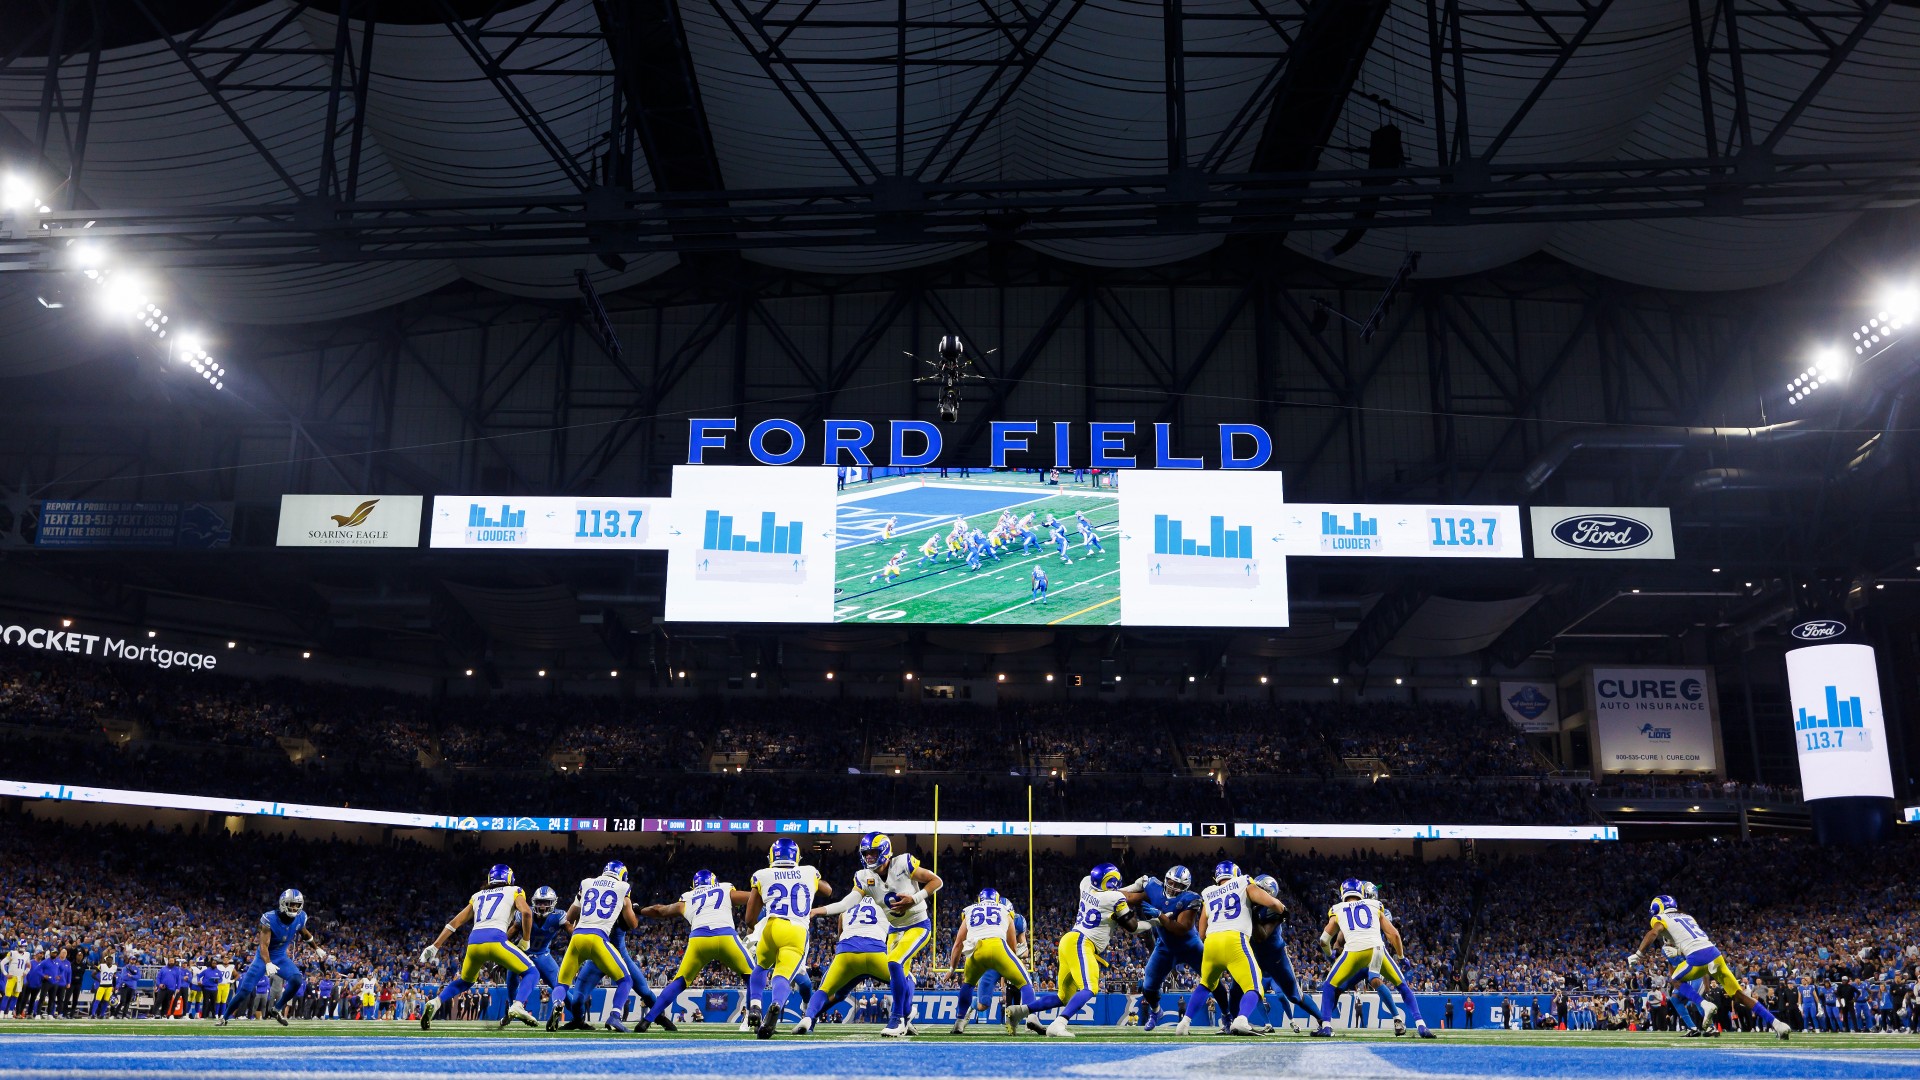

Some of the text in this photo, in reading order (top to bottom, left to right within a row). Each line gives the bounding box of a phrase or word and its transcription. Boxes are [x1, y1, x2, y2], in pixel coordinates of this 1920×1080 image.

[687, 418, 1273, 470] FORD FIELD
[45, 502, 76, 511] REPORT
[76, 502, 82, 511] A
[44, 514, 70, 525] TEXT
[575, 509, 643, 538] 113.7
[42, 526, 66, 536] WITH
[68, 527, 84, 536] THE
[85, 527, 112, 536] ISSUE
[308, 530, 389, 539] SOARING EAGLE
[477, 530, 516, 542] LOUDER
[1431, 518, 1497, 546] 113.7
[1572, 519, 1632, 545] Ford
[1333, 538, 1371, 550] LOUDER
[1801, 623, 1836, 638] Ford
[0, 625, 217, 671] OCKET Mortgage
[1074, 675, 1082, 686] 3
[1597, 679, 1677, 699] CURE
[1600, 702, 1705, 711] AUTO INSURANCE
[1648, 731, 1672, 739] LIONS
[1805, 730, 1844, 751] 113.7
[491, 818, 504, 829] 23
[549, 818, 561, 830] 24
[579, 819, 599, 830] QTR 4
[613, 818, 636, 831] 7:18
[690, 819, 702, 832] 10
[757, 820, 763, 832] 8
[1209, 825, 1218, 835] 3
[774, 870, 802, 880] RIVERS
[592, 879, 615, 888] HIGBEE
[1205, 881, 1240, 900] HAVENSTEIN
[581, 887, 618, 920] 89
[691, 888, 725, 916] 77
[767, 882, 811, 917] 20
[475, 892, 504, 923] 17
[1209, 893, 1242, 923] 79
[847, 903, 878, 926] 73
[969, 906, 1002, 928] 65
[1342, 904, 1373, 931] 10
[1674, 917, 1706, 940] 15
[17, 958, 25, 970] 11
[102, 972, 113, 981] 26
